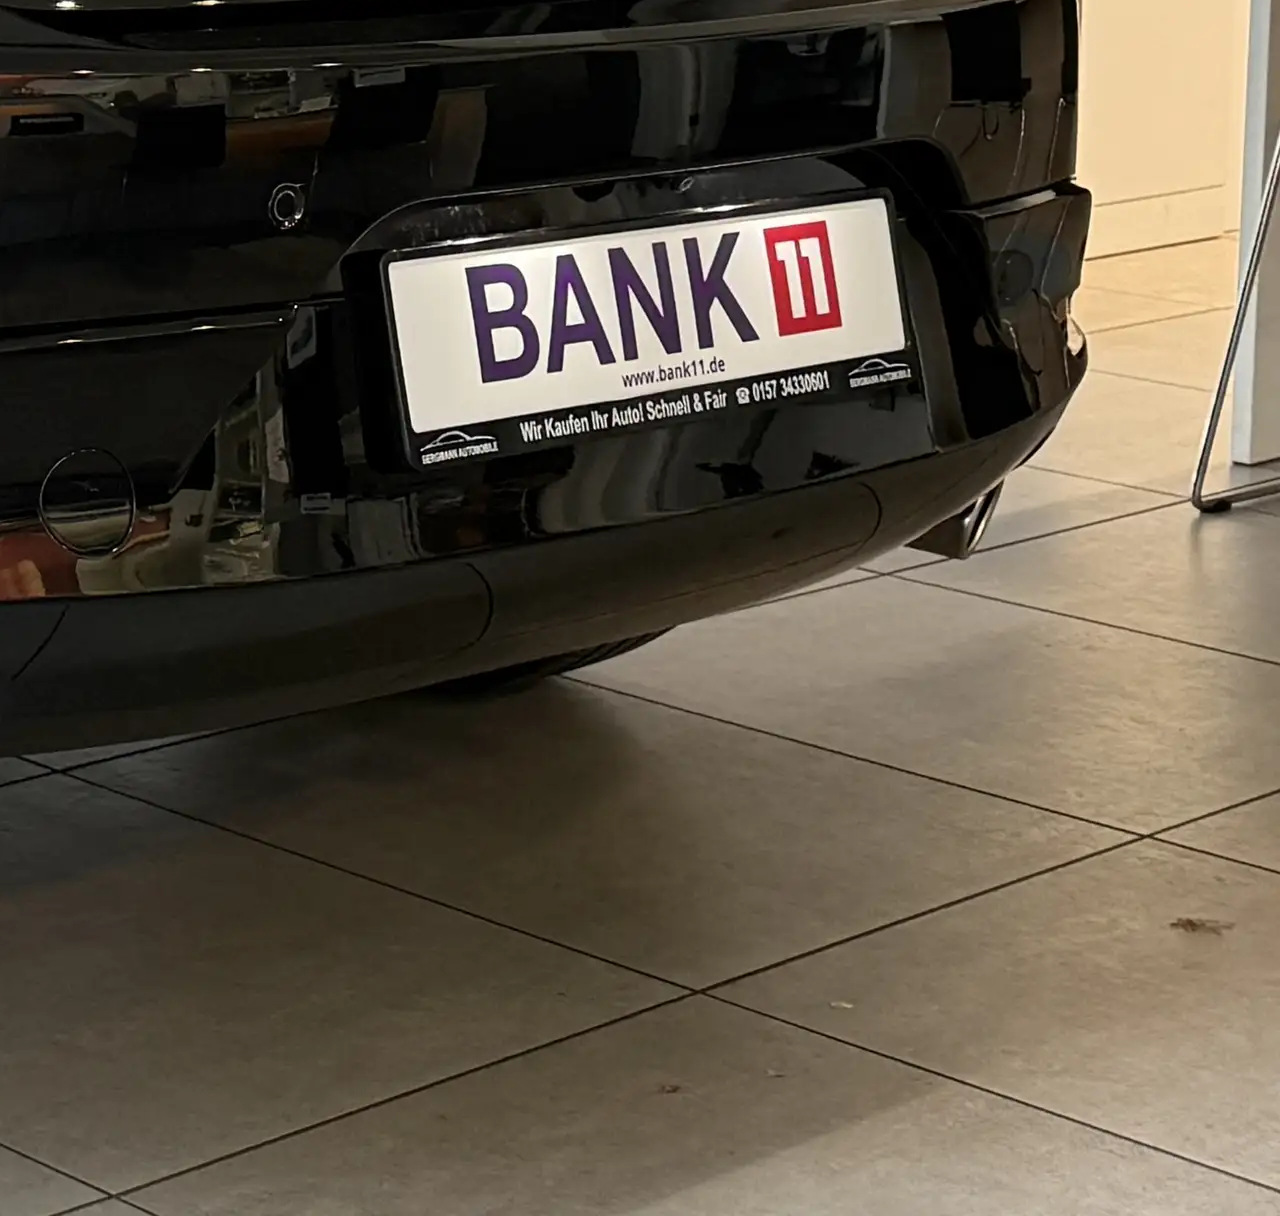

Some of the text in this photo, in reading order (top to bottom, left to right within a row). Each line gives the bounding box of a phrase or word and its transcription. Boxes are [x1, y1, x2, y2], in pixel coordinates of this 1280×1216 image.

[465, 231, 832, 384] BANK 11
[621, 356, 726, 388] www.bank11.de
[520, 421, 542, 443] Wir
[544, 412, 590, 438] Kaufen
[591, 410, 608, 431] Ihr
[611, 403, 644, 428] Auto!
[646, 394, 691, 421] Schnell
[693, 392, 704, 413] &
[704, 388, 727, 410] Fair
[752, 379, 778, 402] 0157
